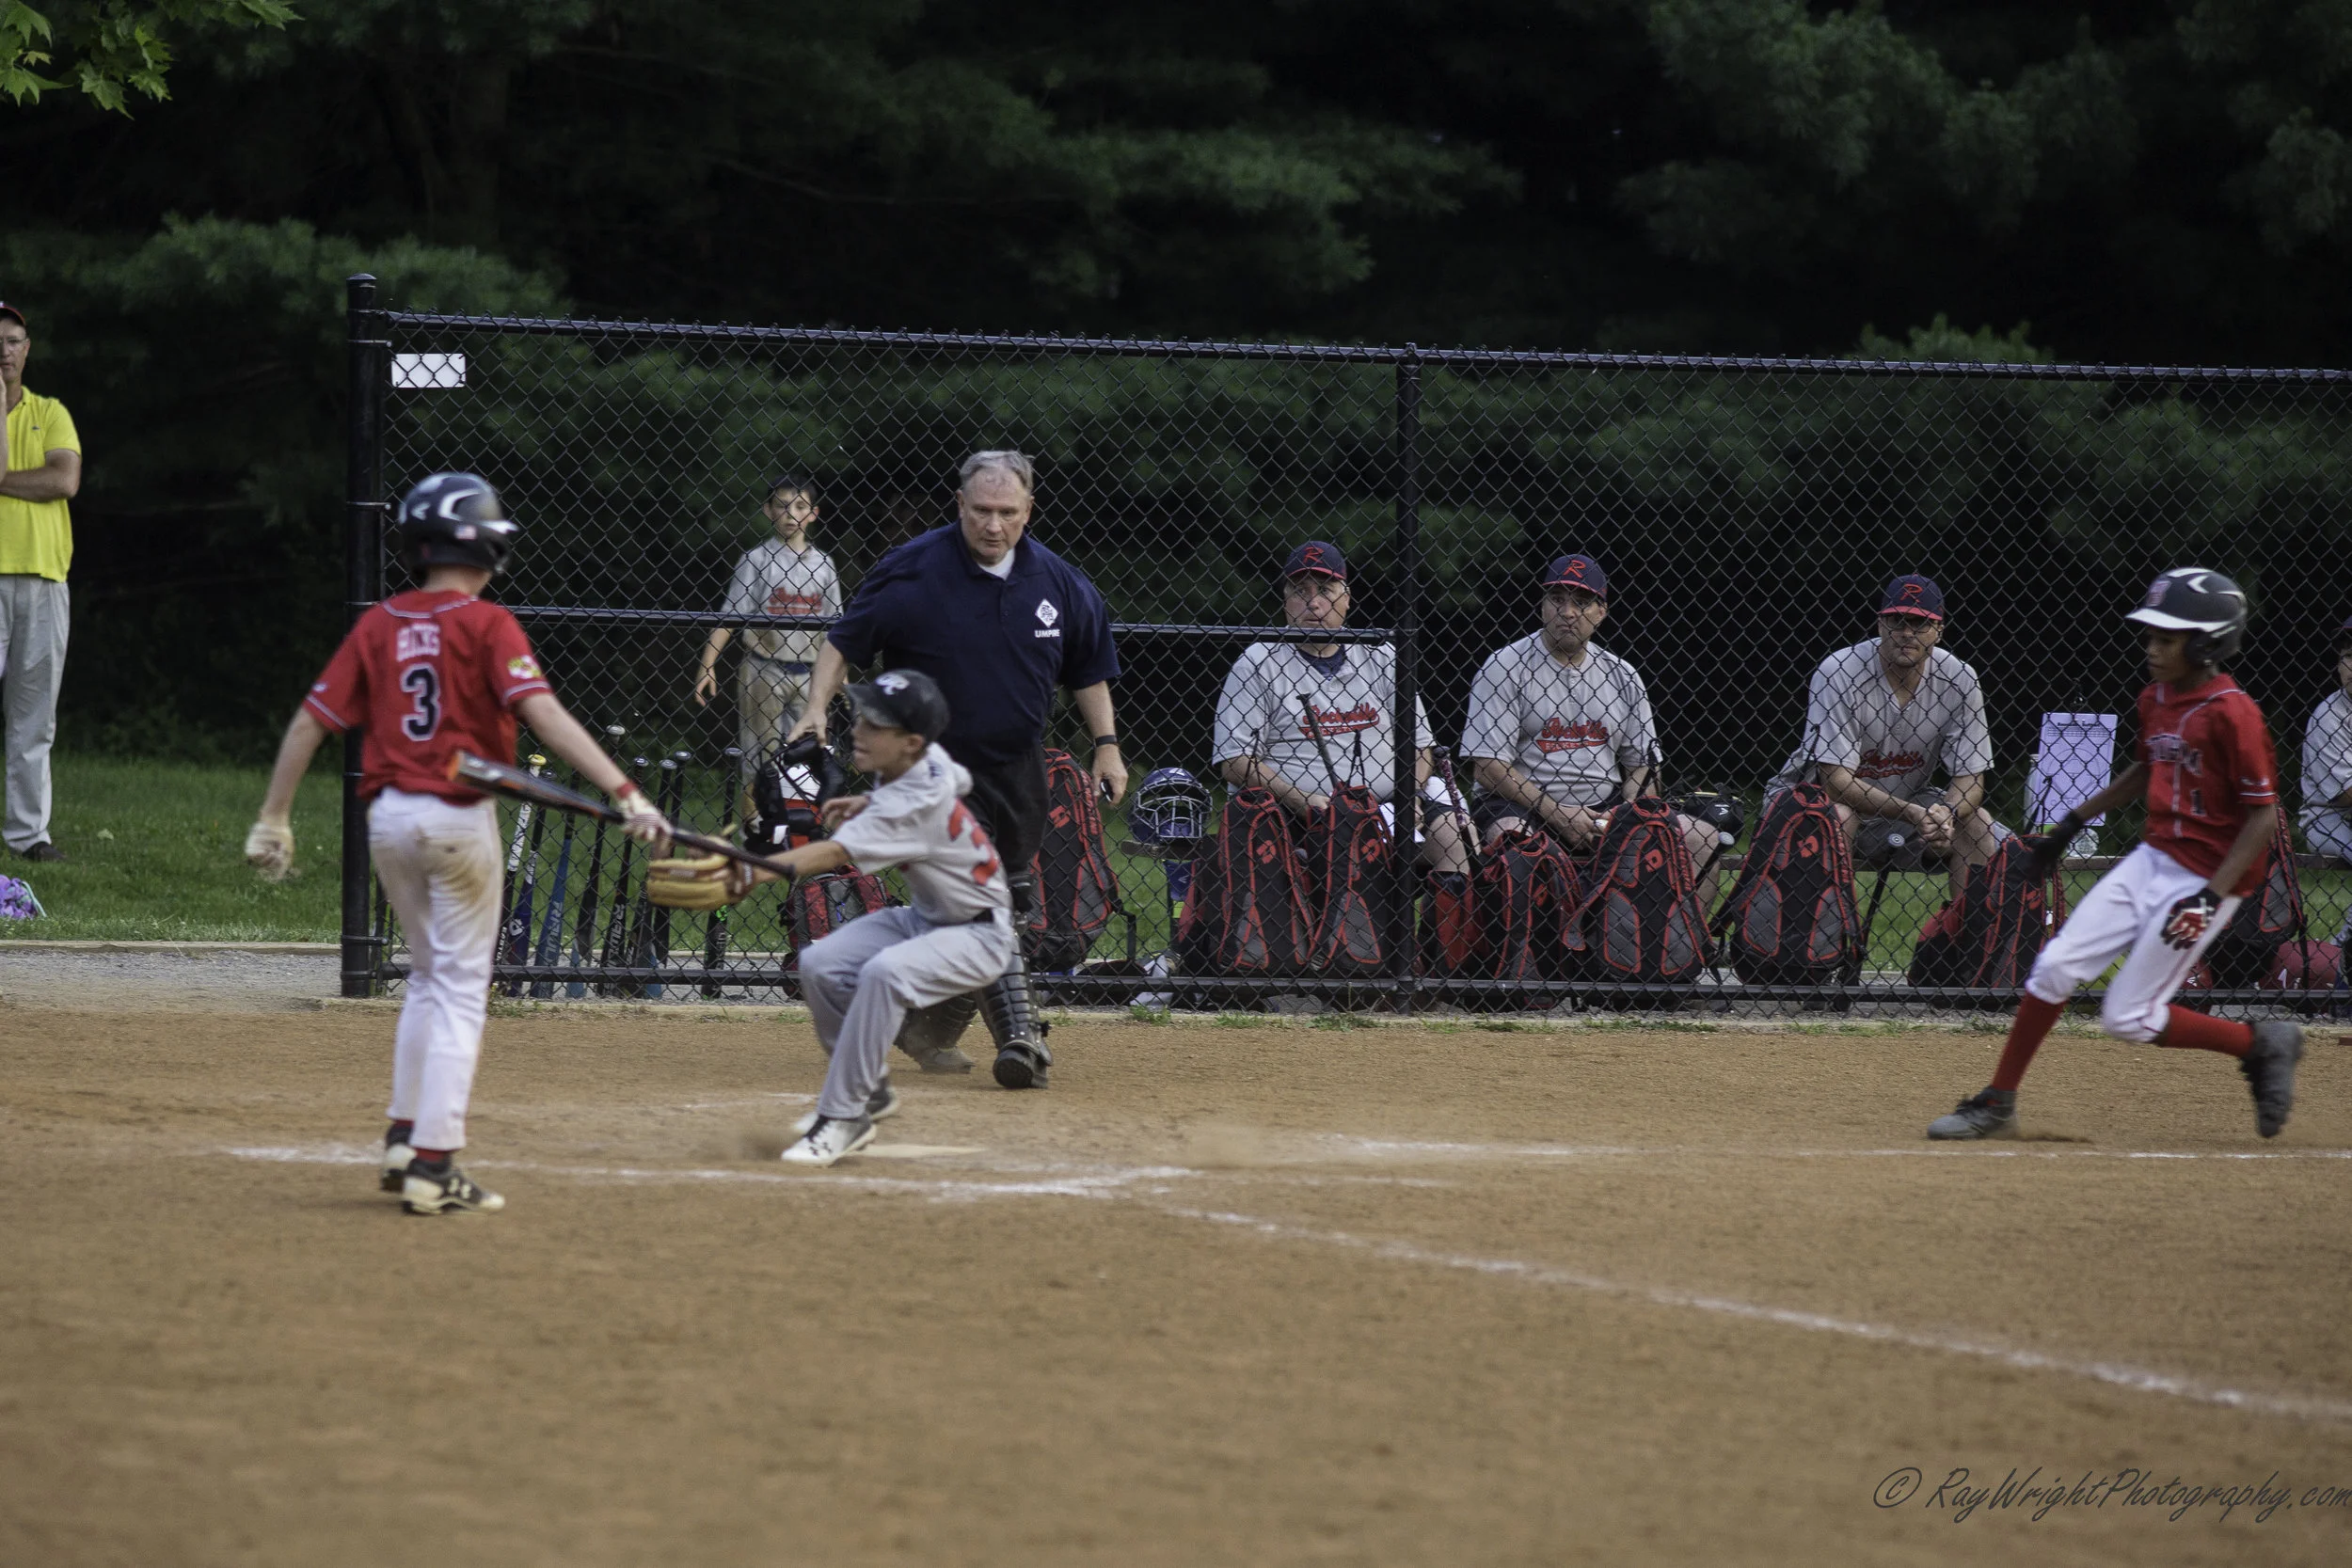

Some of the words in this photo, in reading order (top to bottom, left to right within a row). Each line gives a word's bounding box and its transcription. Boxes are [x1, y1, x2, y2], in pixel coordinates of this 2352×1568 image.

[1302, 546, 1325, 563] R
[1563, 560, 1586, 578] R
[1900, 583, 1923, 603] R
[1034, 628, 1061, 639] UMPIRE
[400, 662, 441, 742] 3
